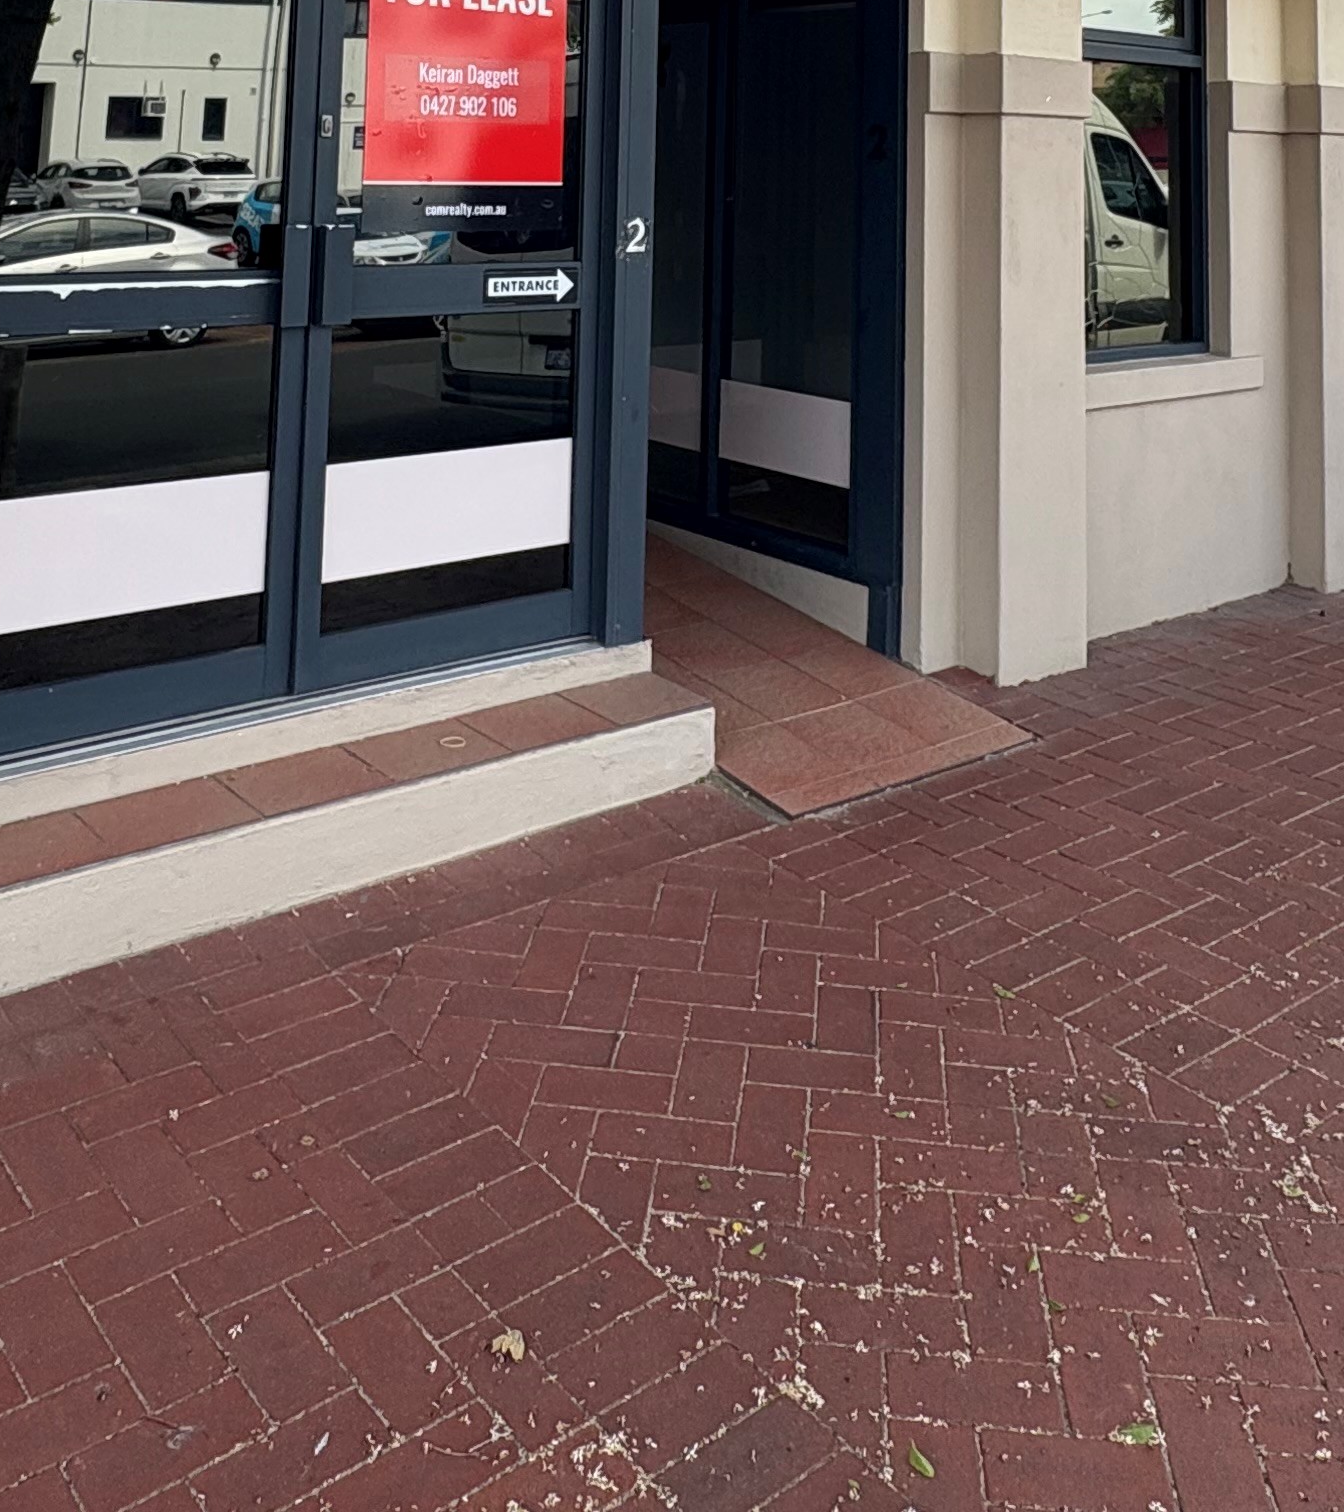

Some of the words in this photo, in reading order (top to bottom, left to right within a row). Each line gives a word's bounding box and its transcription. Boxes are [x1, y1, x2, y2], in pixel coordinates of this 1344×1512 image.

[419, 62, 463, 84] Keiran
[467, 64, 519, 89] Daggett
[420, 95, 456, 116] 0427
[459, 96, 487, 116] 902
[491, 97, 517, 117] 106
[425, 202, 506, 218] comrealty.com.au
[625, 217, 647, 253] 2
[492, 278, 559, 294] ENTRANCE
